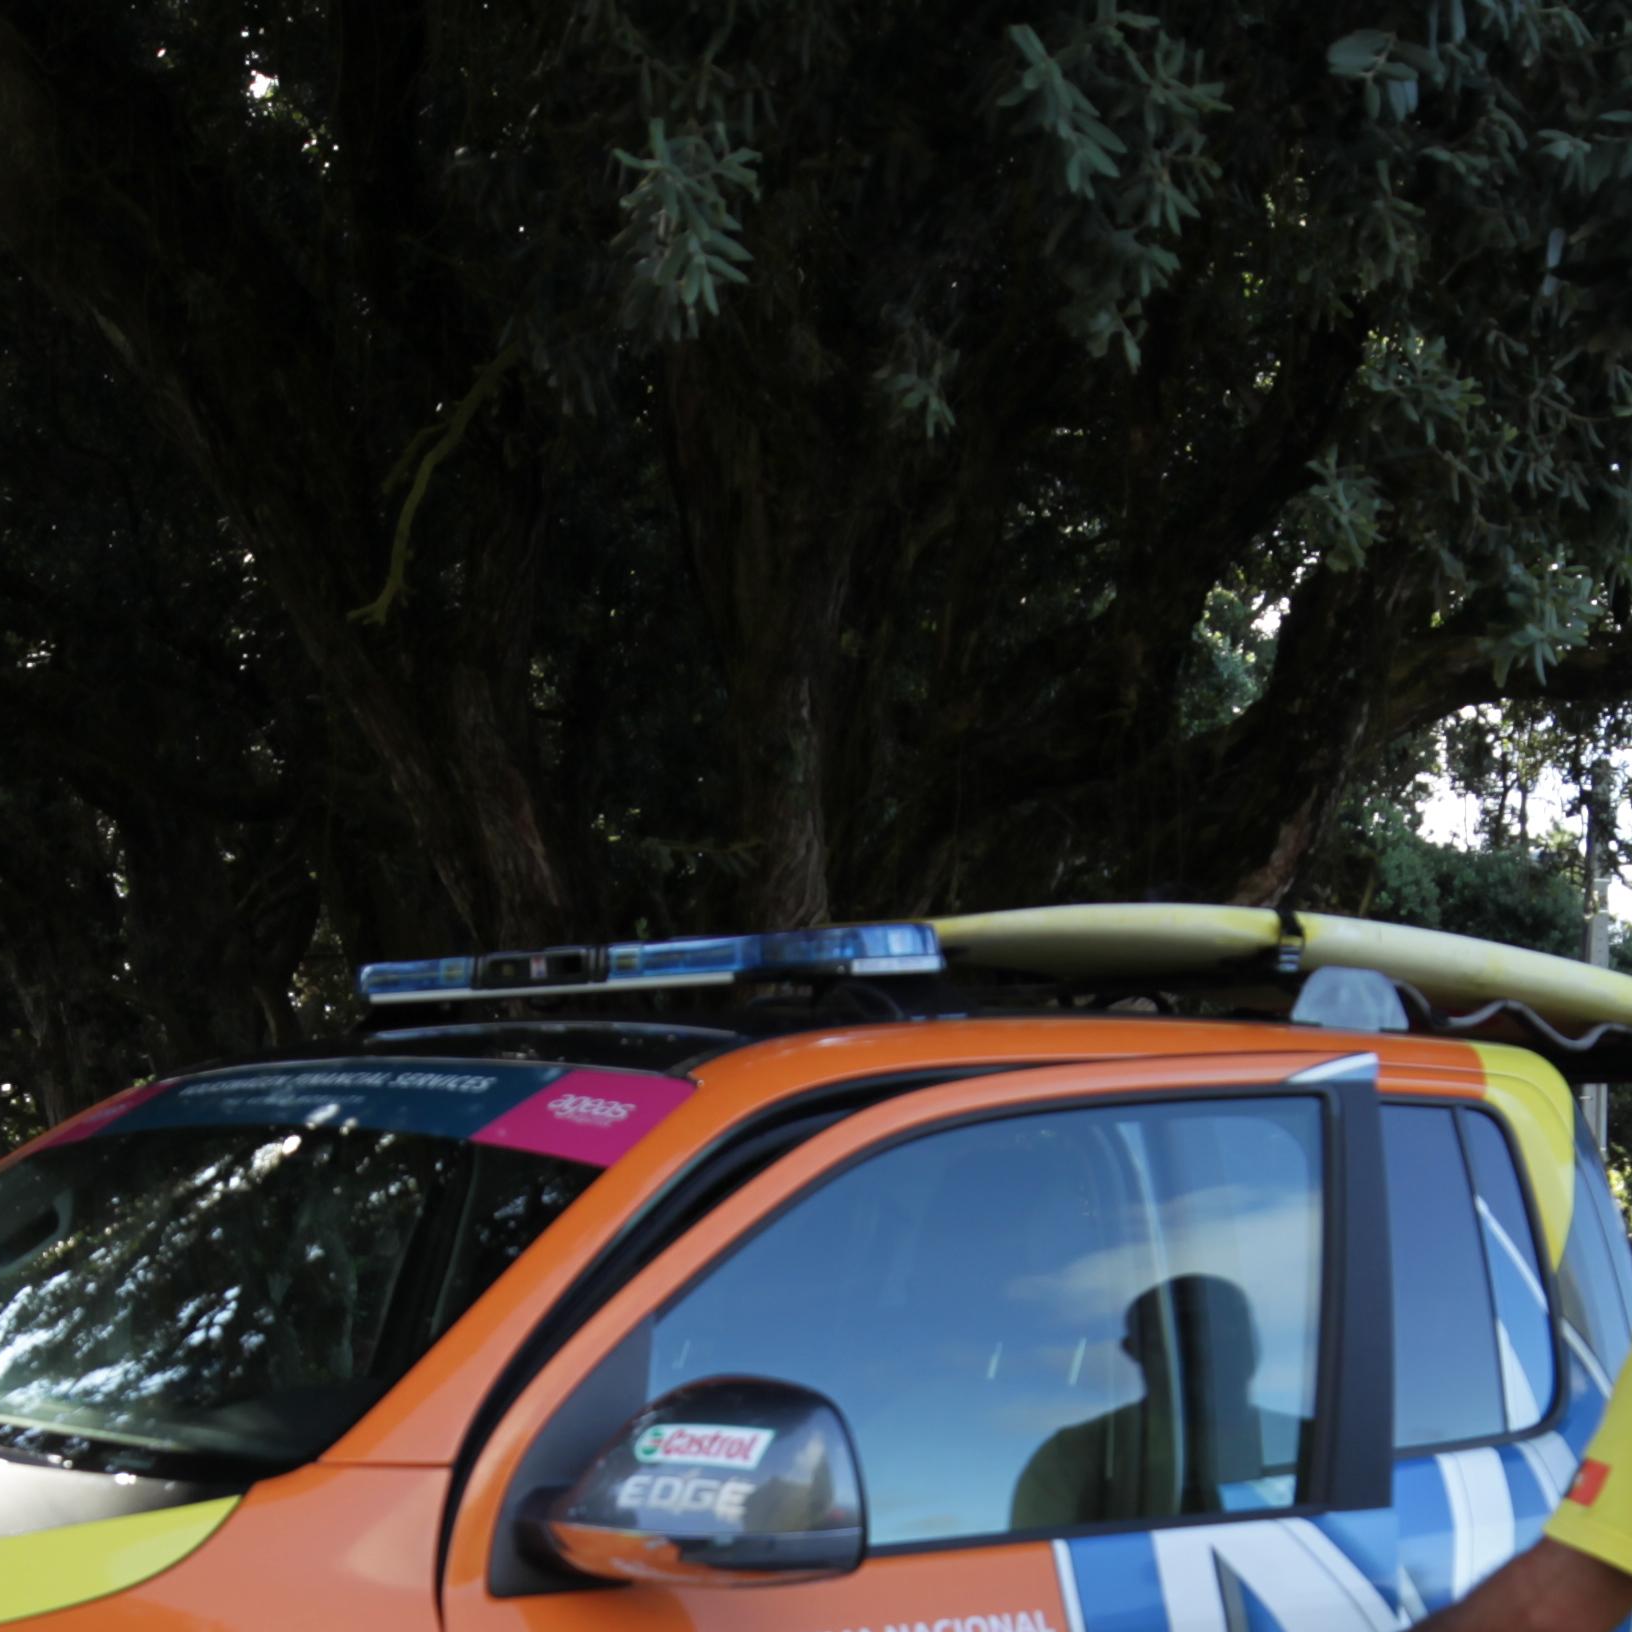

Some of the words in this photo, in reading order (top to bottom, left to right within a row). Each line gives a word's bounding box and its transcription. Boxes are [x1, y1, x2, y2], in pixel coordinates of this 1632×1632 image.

[293, 1072, 393, 1088] FINANCIAL
[388, 1072, 497, 1093] SERVICES
[547, 1093, 636, 1121] ageas
[661, 1428, 760, 1462] Castrol
[617, 1474, 756, 1524] EDGE
